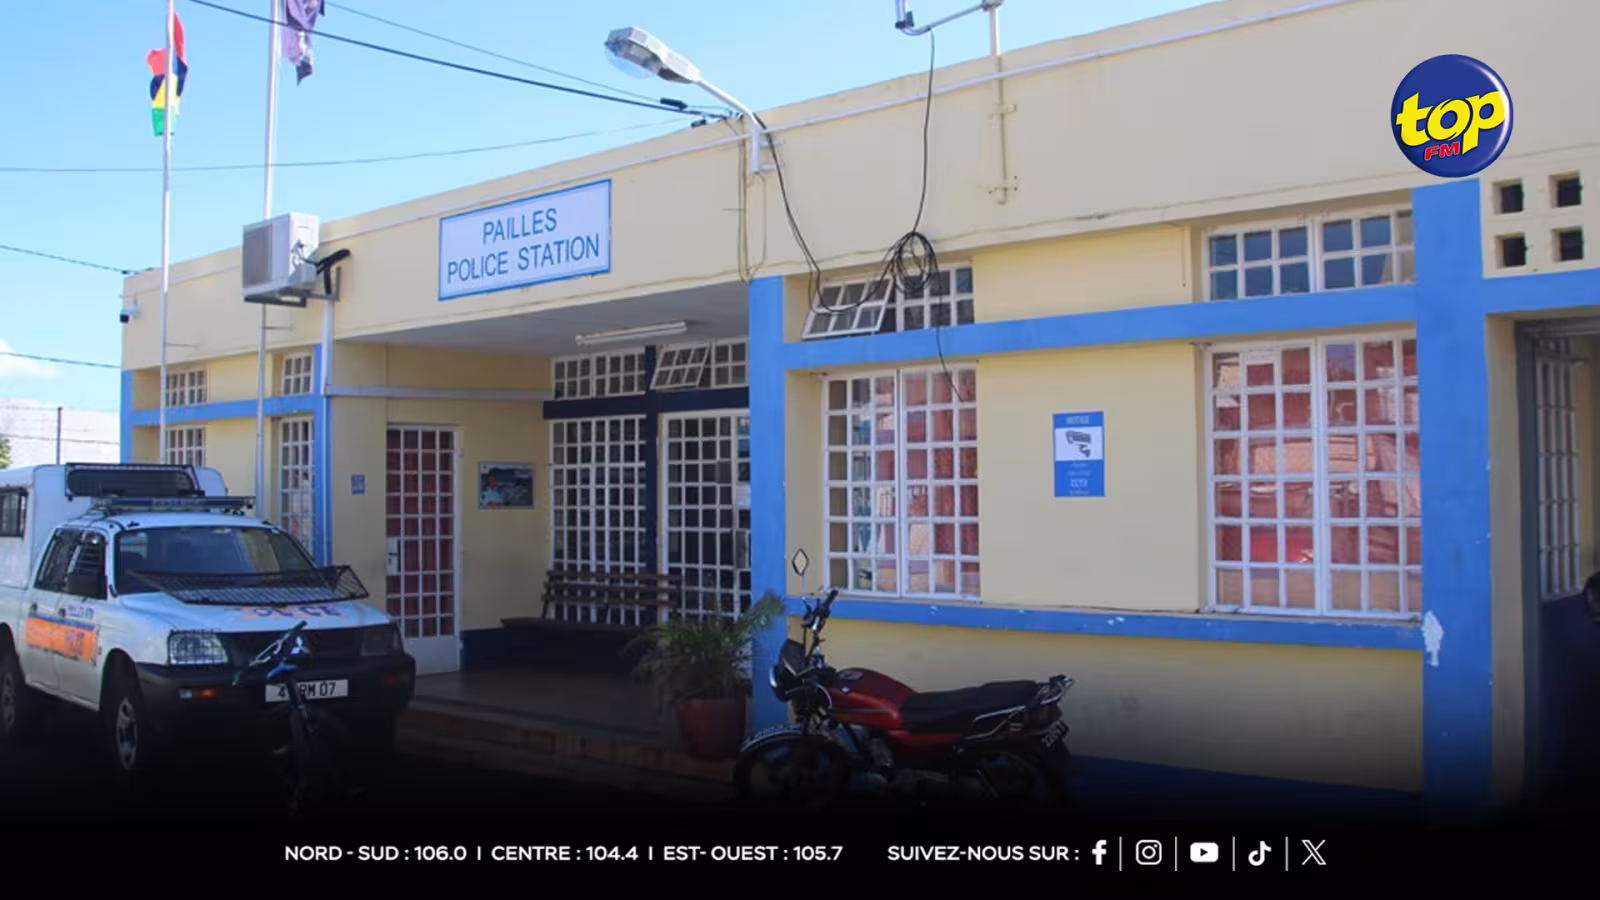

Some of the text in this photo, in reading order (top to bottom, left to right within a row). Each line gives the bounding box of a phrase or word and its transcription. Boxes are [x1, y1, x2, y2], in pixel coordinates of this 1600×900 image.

[483, 208, 557, 244] PAILLES
[448, 233, 599, 283] POLICE STATION
[319, 682, 336, 697] 07
